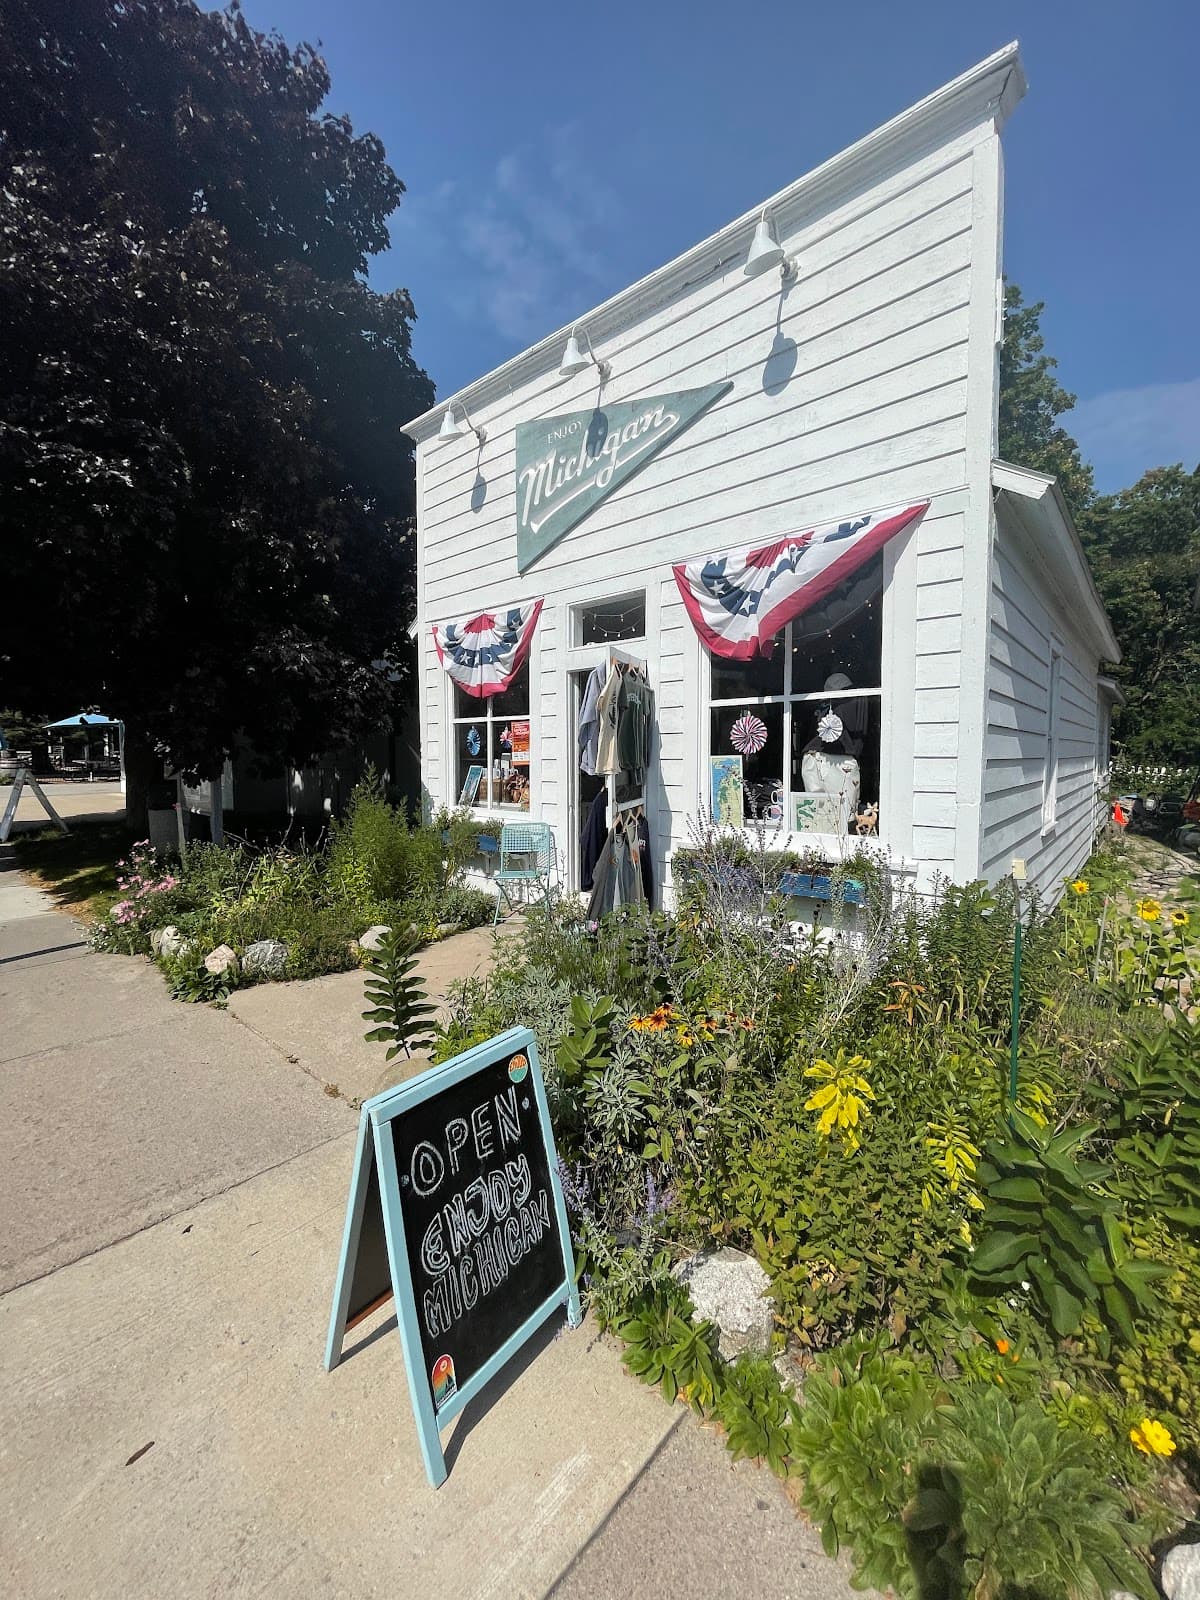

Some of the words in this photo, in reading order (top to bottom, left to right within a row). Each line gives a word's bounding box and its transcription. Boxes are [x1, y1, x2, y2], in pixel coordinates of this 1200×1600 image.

[411, 1085, 522, 1196] OPEN
[421, 1153, 532, 1276] ENJOY
[424, 1189, 551, 1339] MICHIGAN
